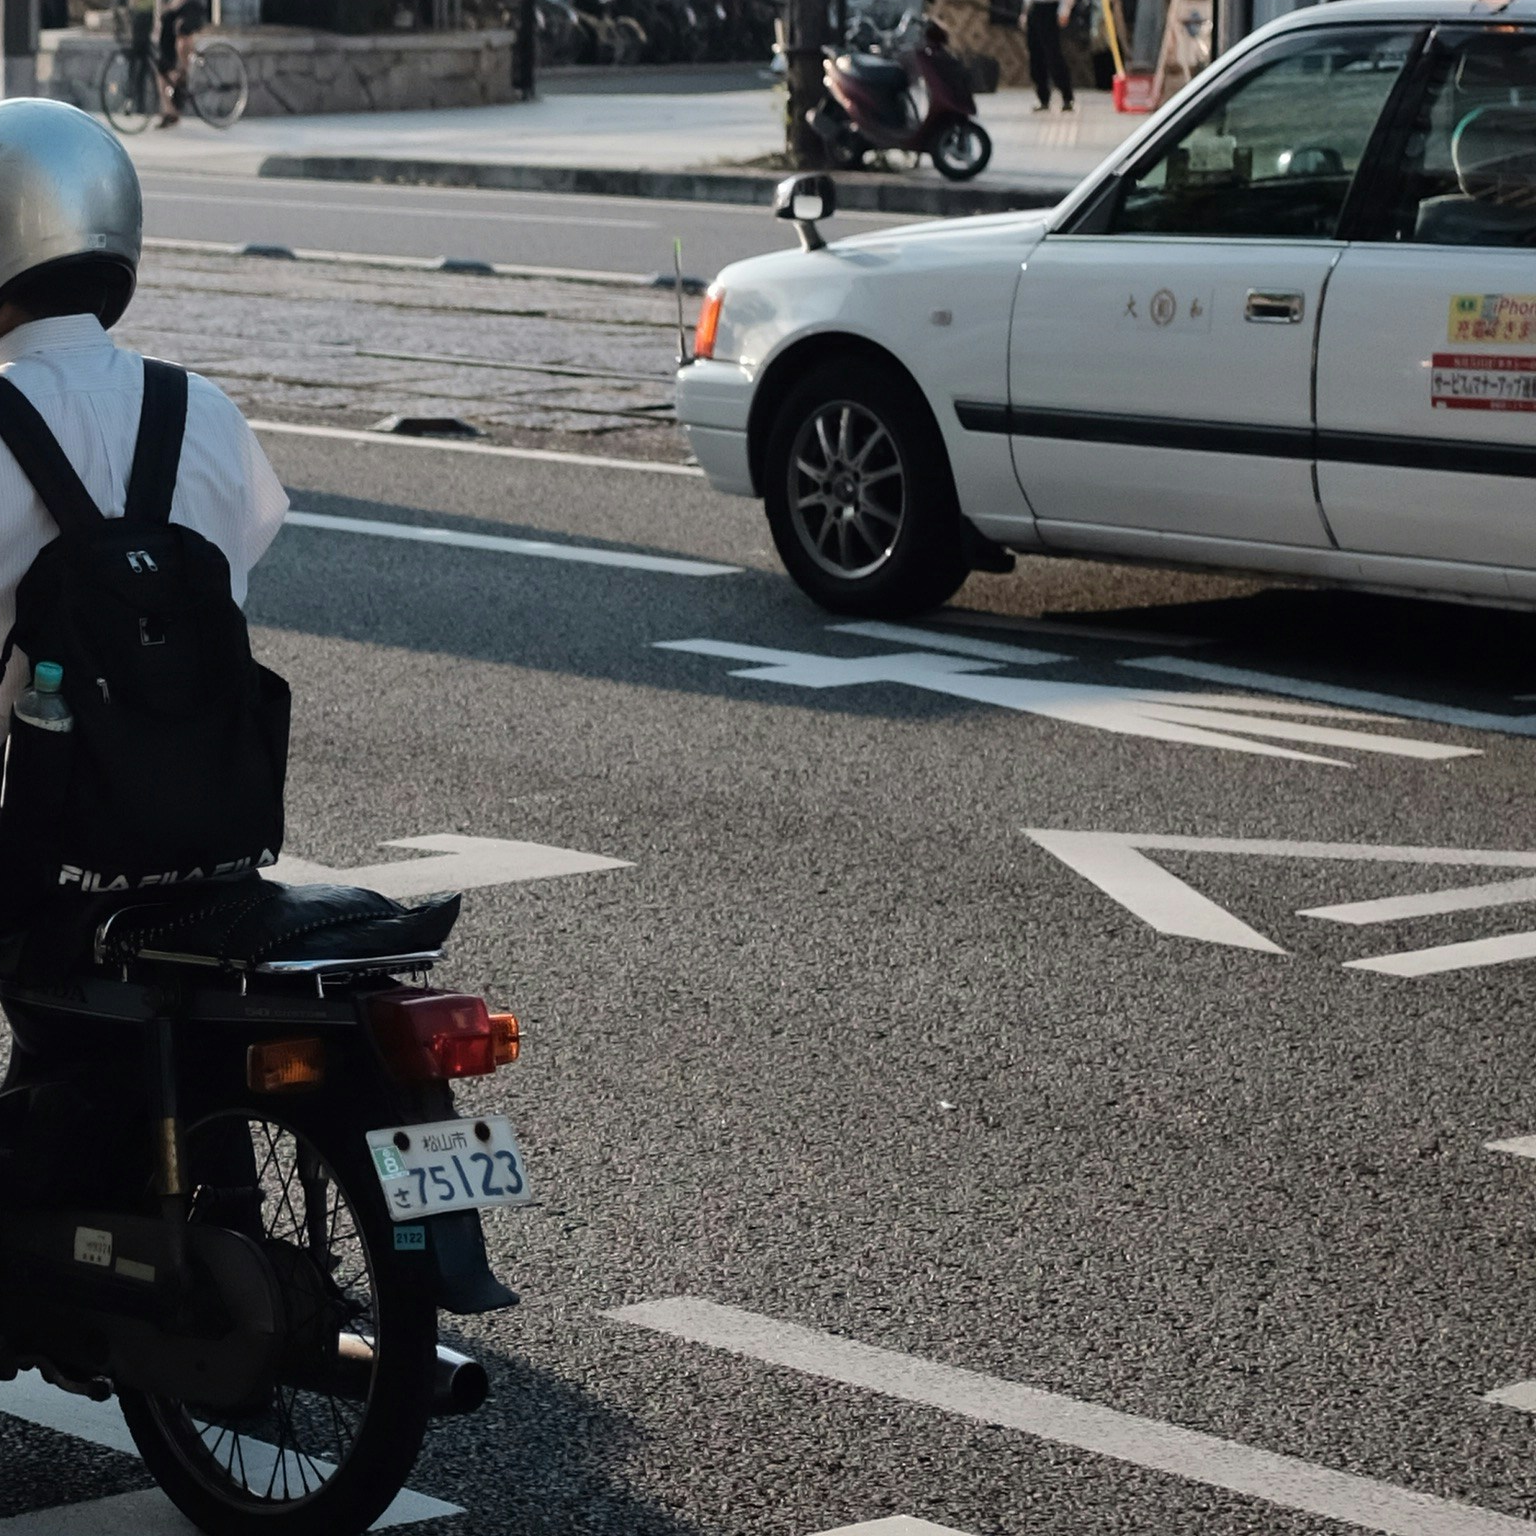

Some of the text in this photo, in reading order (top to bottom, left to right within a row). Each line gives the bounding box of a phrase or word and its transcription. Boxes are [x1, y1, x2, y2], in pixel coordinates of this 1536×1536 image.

[58, 864, 130, 893] FILA
[423, 1131, 468, 1153] 松山市
[409, 1150, 524, 1205] 75123
[396, 1232, 424, 1244] 2122
